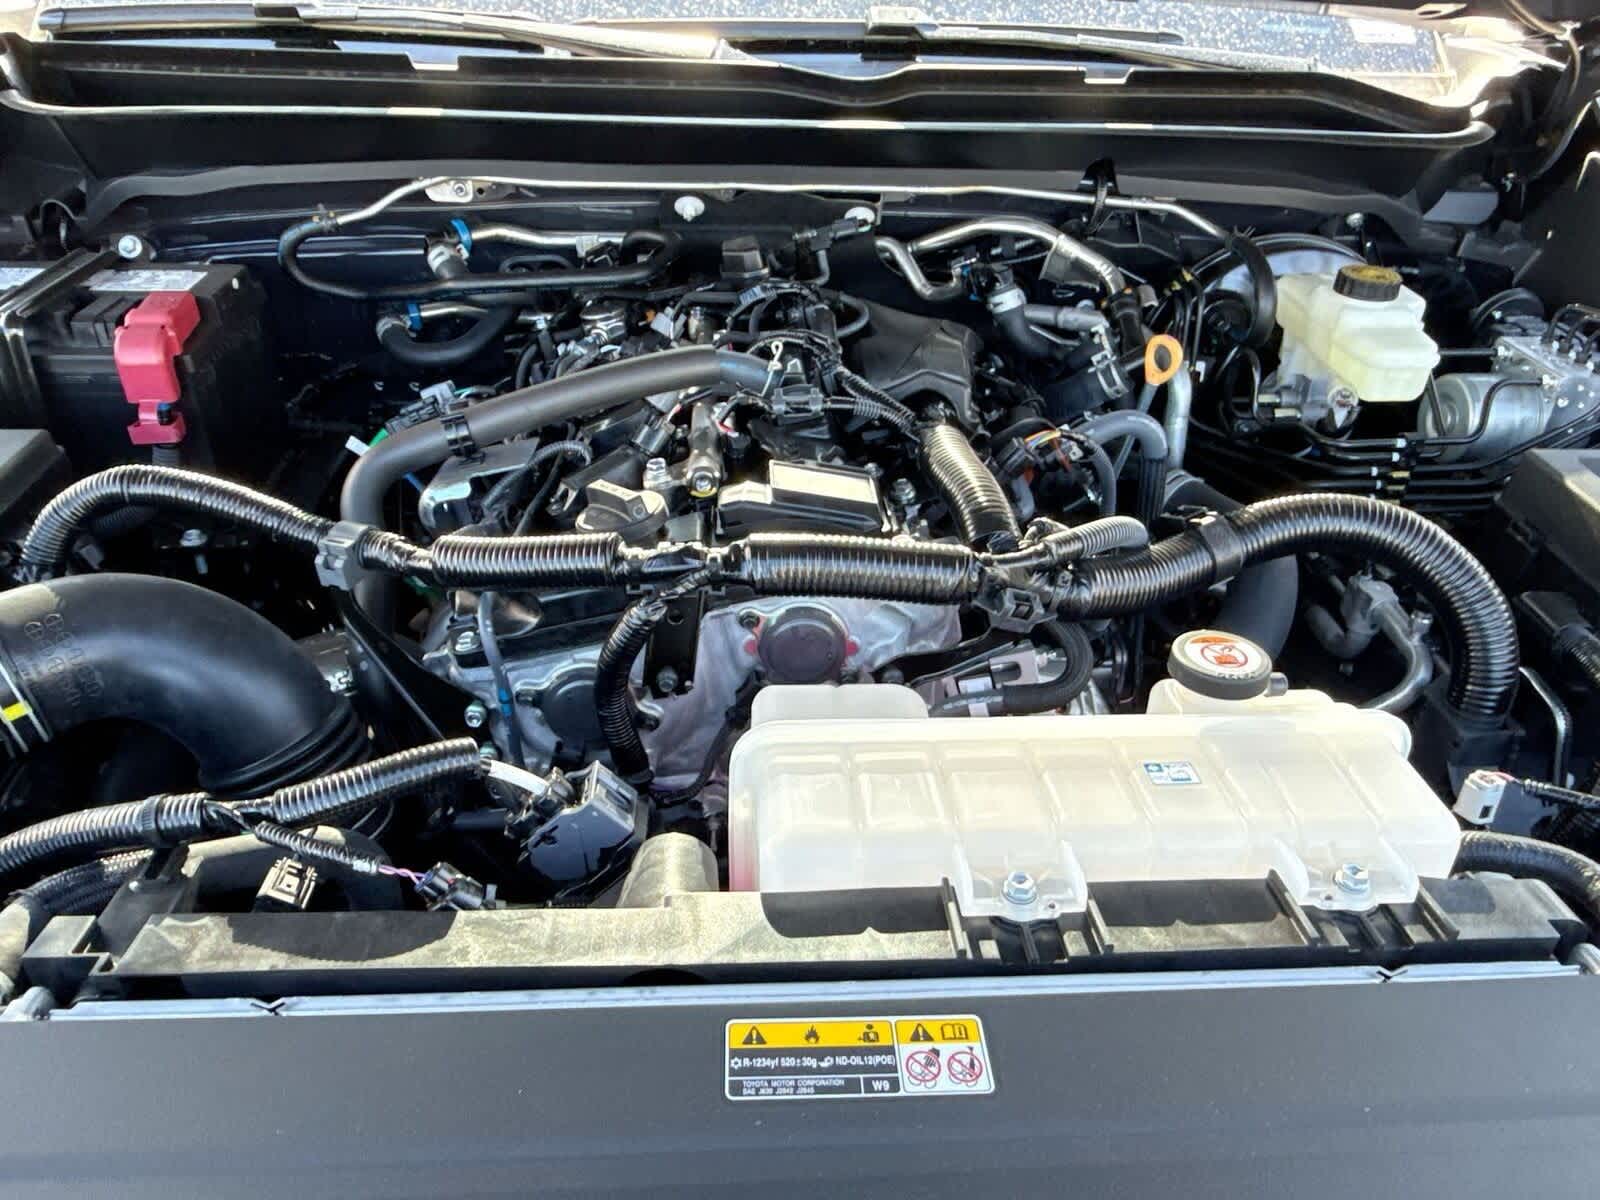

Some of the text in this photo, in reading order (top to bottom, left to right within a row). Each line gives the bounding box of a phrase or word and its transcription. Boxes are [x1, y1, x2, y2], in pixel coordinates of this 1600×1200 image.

[743, 1057, 779, 1069] R-1234yf
[835, 1054, 896, 1067] ND-OIL12(POE)
[743, 1078, 845, 1088] TOYOTA MOTOR CORPORATION
[871, 1080, 890, 1092] W9
